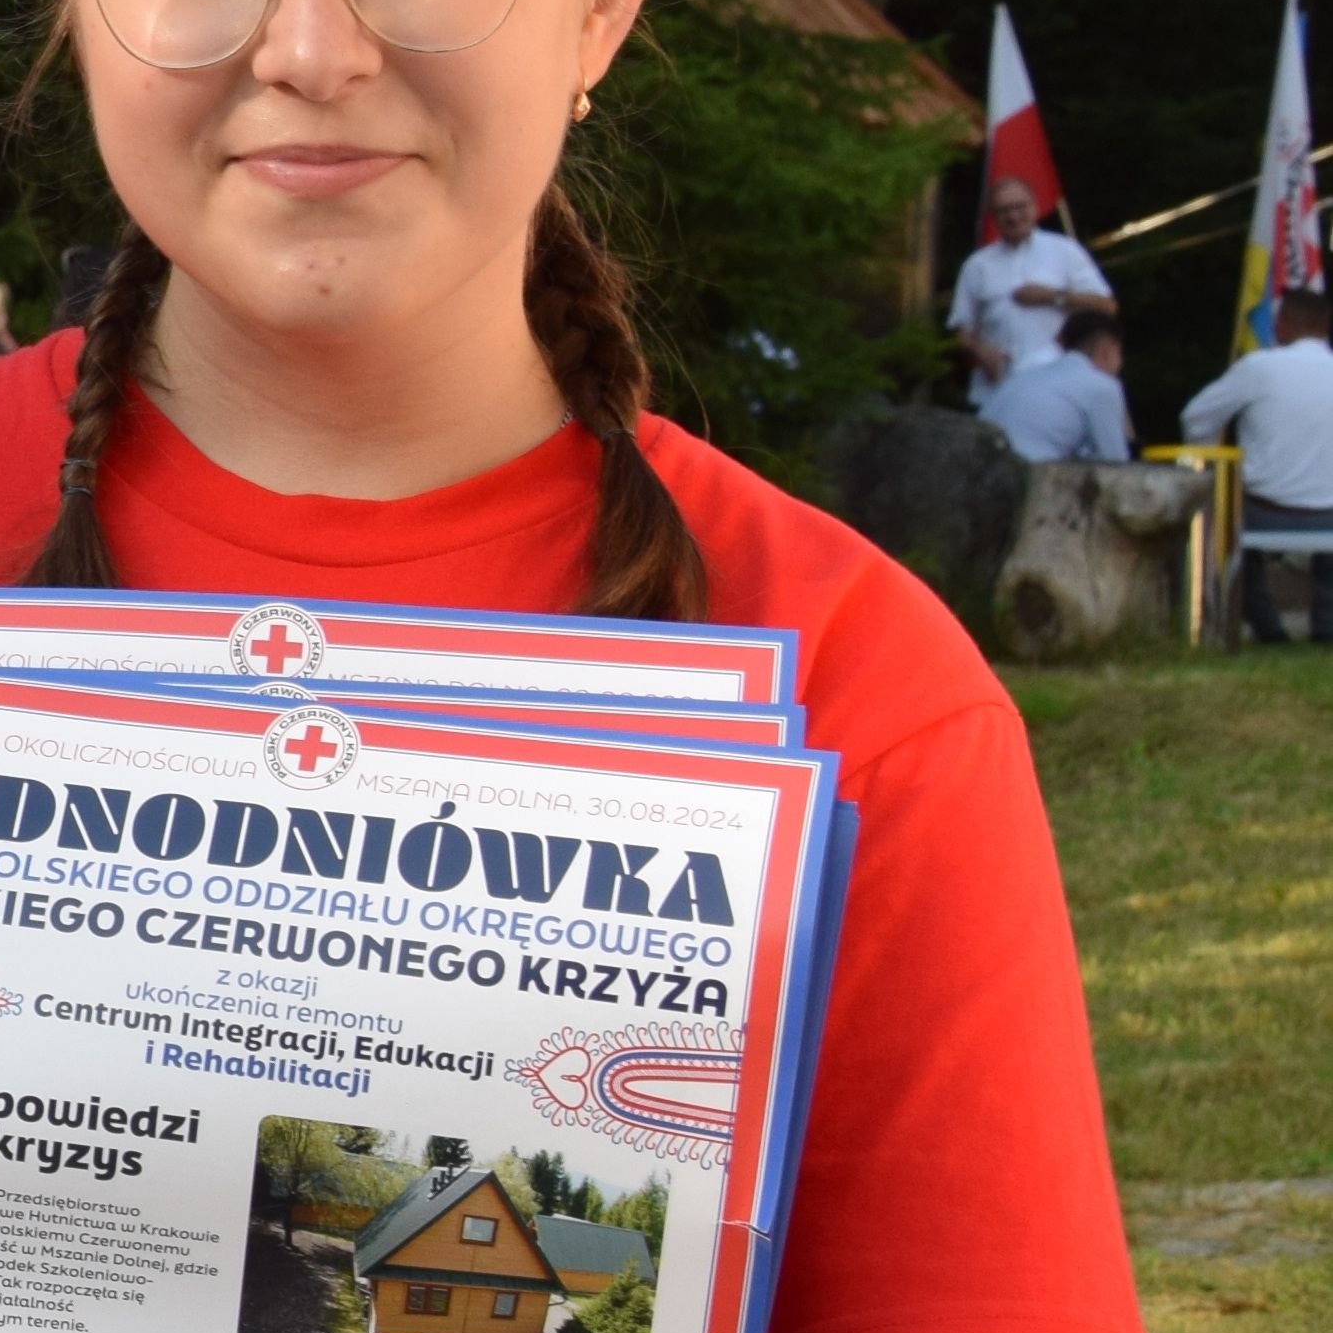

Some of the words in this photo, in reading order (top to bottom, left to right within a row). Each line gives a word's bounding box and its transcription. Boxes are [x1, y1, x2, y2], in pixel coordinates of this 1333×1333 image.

[4, 735, 257, 779] OKOLICZNOŚCIOWA
[267, 732, 287, 779] POLSKI
[279, 710, 354, 739] CZERWONY
[357, 773, 470, 802] MSZANA
[478, 785, 577, 814] DOLNA,
[587, 797, 743, 829] 30.08.2024
[203, 875, 409, 926] ODDZIAŁU
[419, 901, 732, 967] OKRĘGOWEGO
[136, 908, 506, 987] CZERWONEGO
[518, 955, 728, 1017] KRZYŻA
[216, 969, 231, 986] z
[237, 970, 318, 1000] okazji
[126, 983, 279, 1019] ukończenia
[286, 1005, 403, 1035] remontu
[34, 994, 172, 1034] Centrum
[181, 1012, 345, 1063] Integracji,
[353, 1035, 494, 1081] Edukacji
[145, 1040, 154, 1064] i
[162, 1043, 371, 1098] Rehabilitacji
[29, 1210, 116, 1231] Hutnictwa
[121, 1224, 136, 1233] w
[140, 1223, 220, 1243] Krakowie
[79, 1233, 190, 1256] Czerwonemu
[21, 1246, 36, 1255] w
[41, 1246, 109, 1264] Mszanie
[113, 1253, 169, 1273] Dolnej,
[174, 1263, 218, 1276] gdzie
[40, 1262, 153, 1285] Szkoleniowo-
[26, 1281, 118, 1300] rozpoczęła
[122, 1290, 145, 1305] się
[27, 1316, 88, 1332] terenie.
